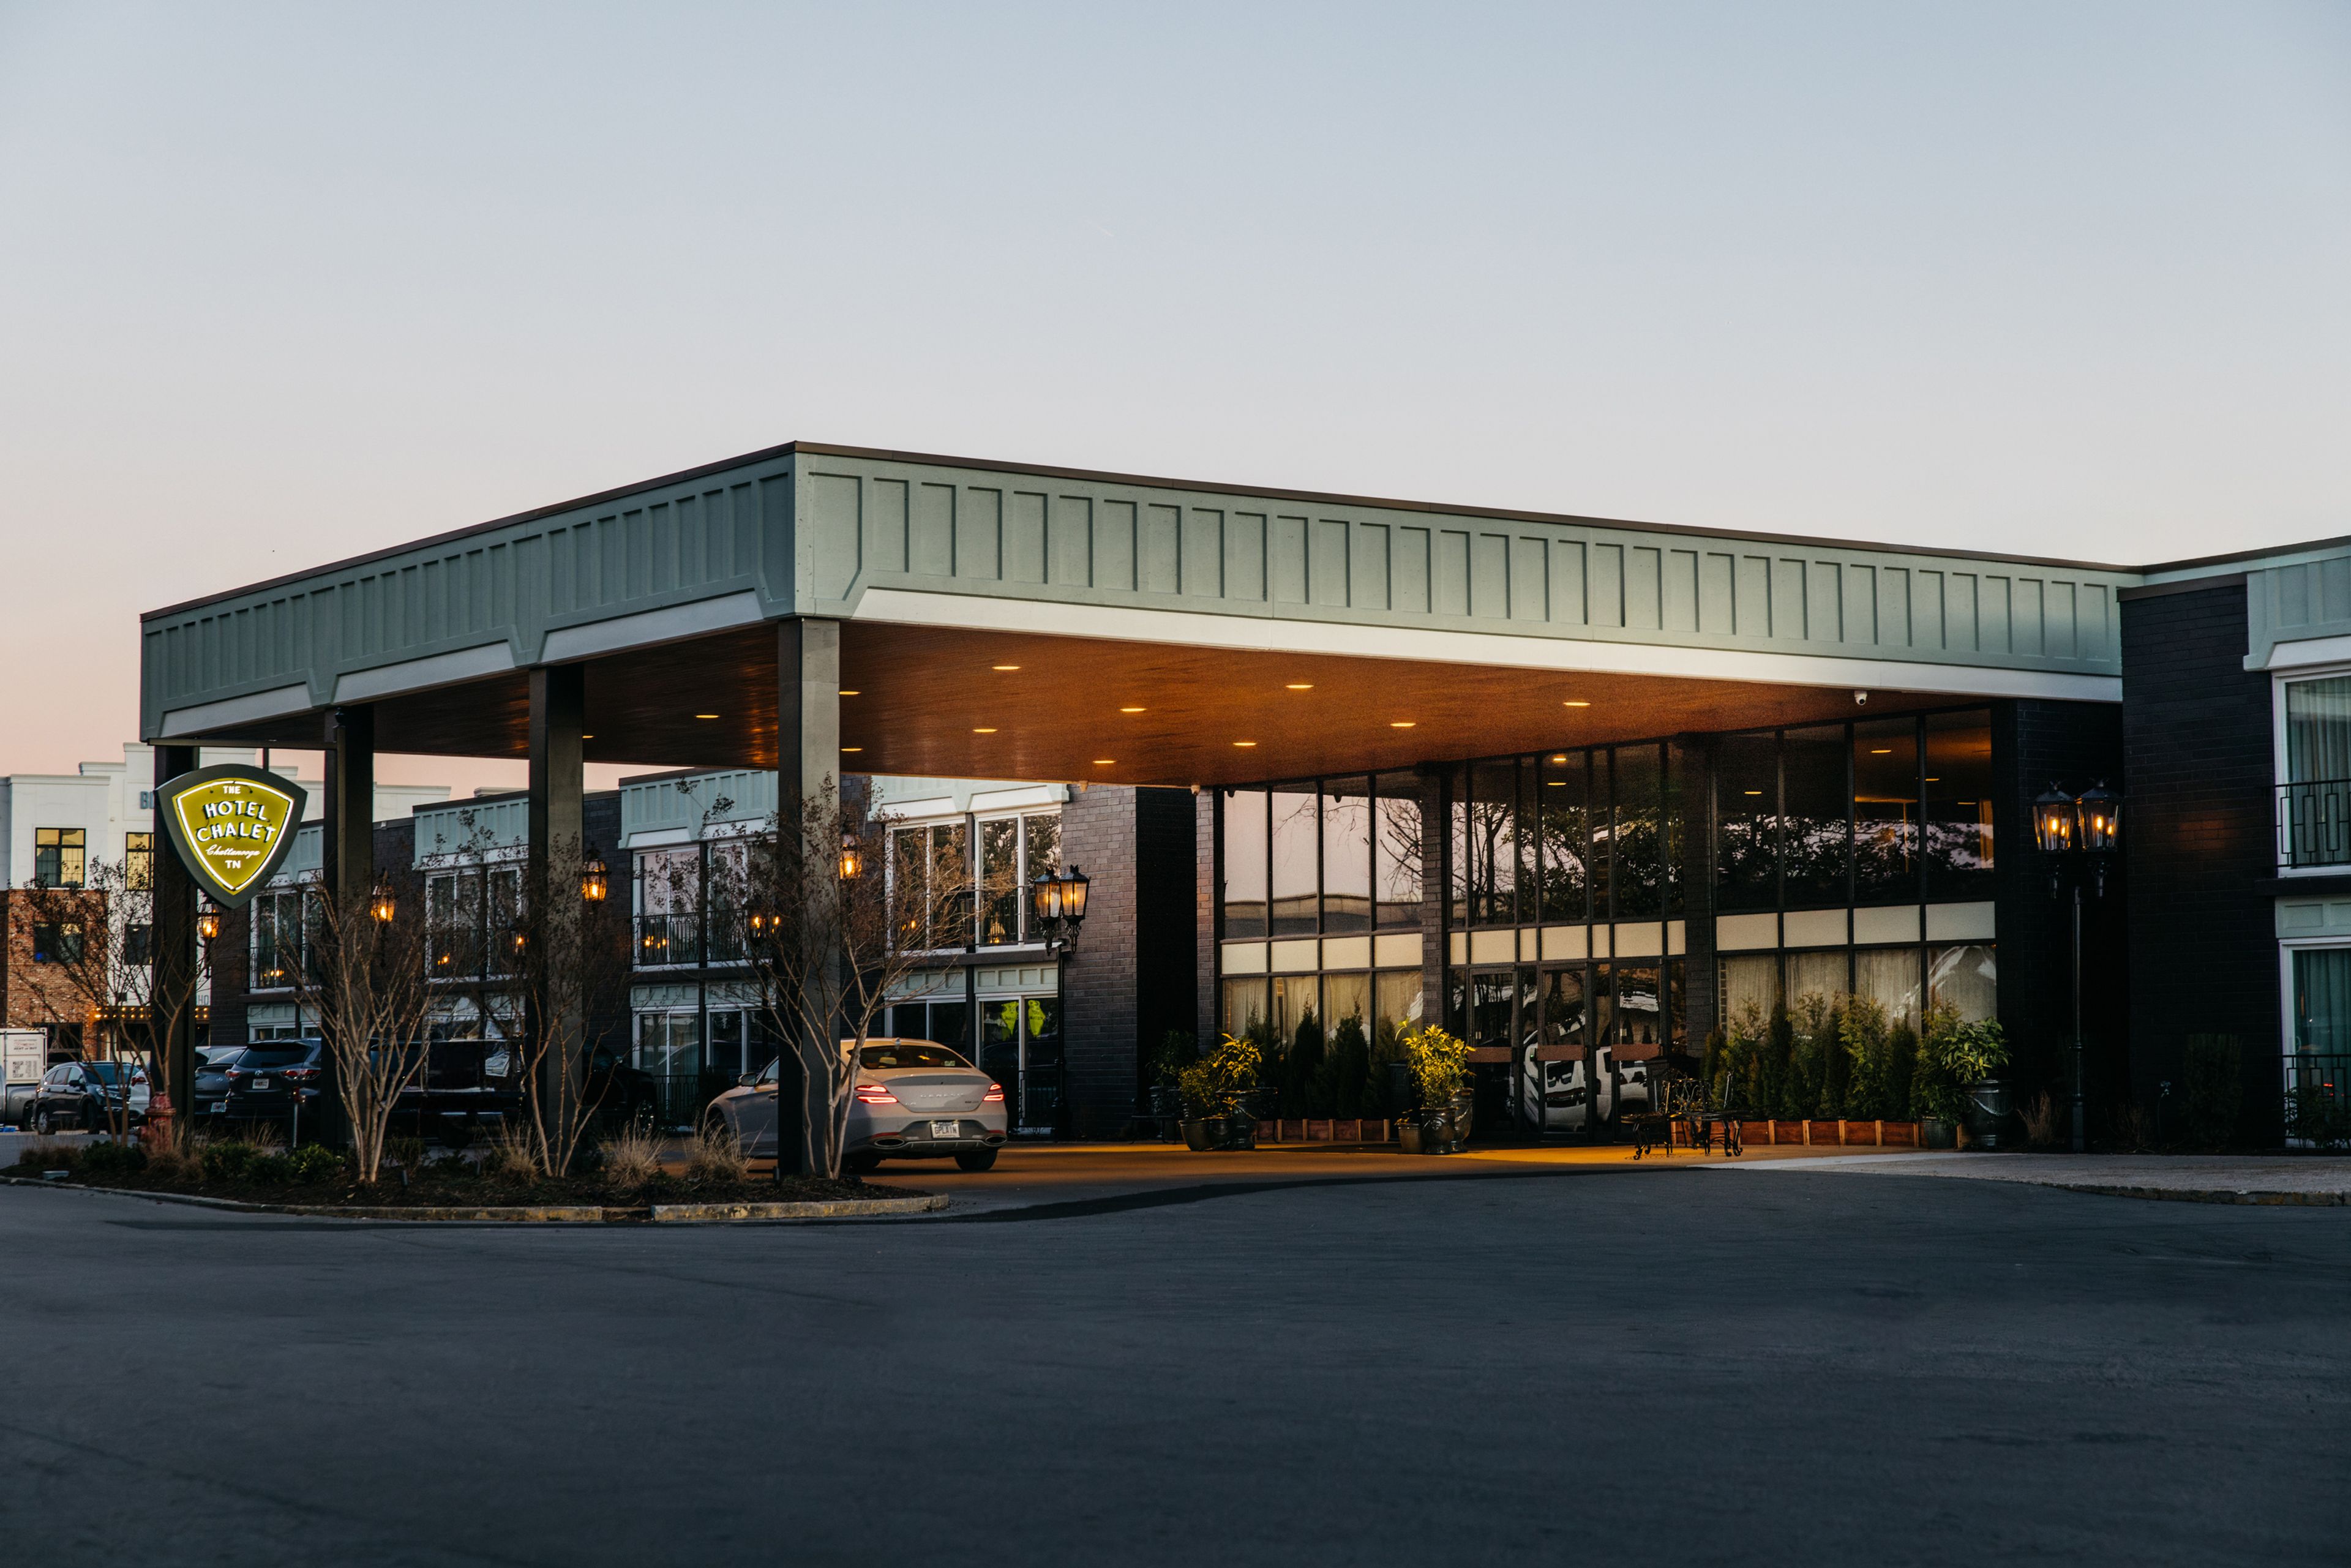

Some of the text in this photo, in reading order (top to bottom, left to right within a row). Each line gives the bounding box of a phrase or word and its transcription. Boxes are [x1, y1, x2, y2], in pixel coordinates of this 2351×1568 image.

[223, 786, 241, 794] THE
[204, 801, 267, 820] HOTEL
[197, 822, 276, 842] CHALET
[206, 844, 260, 859] Chattanooga
[225, 860, 241, 869] TN
